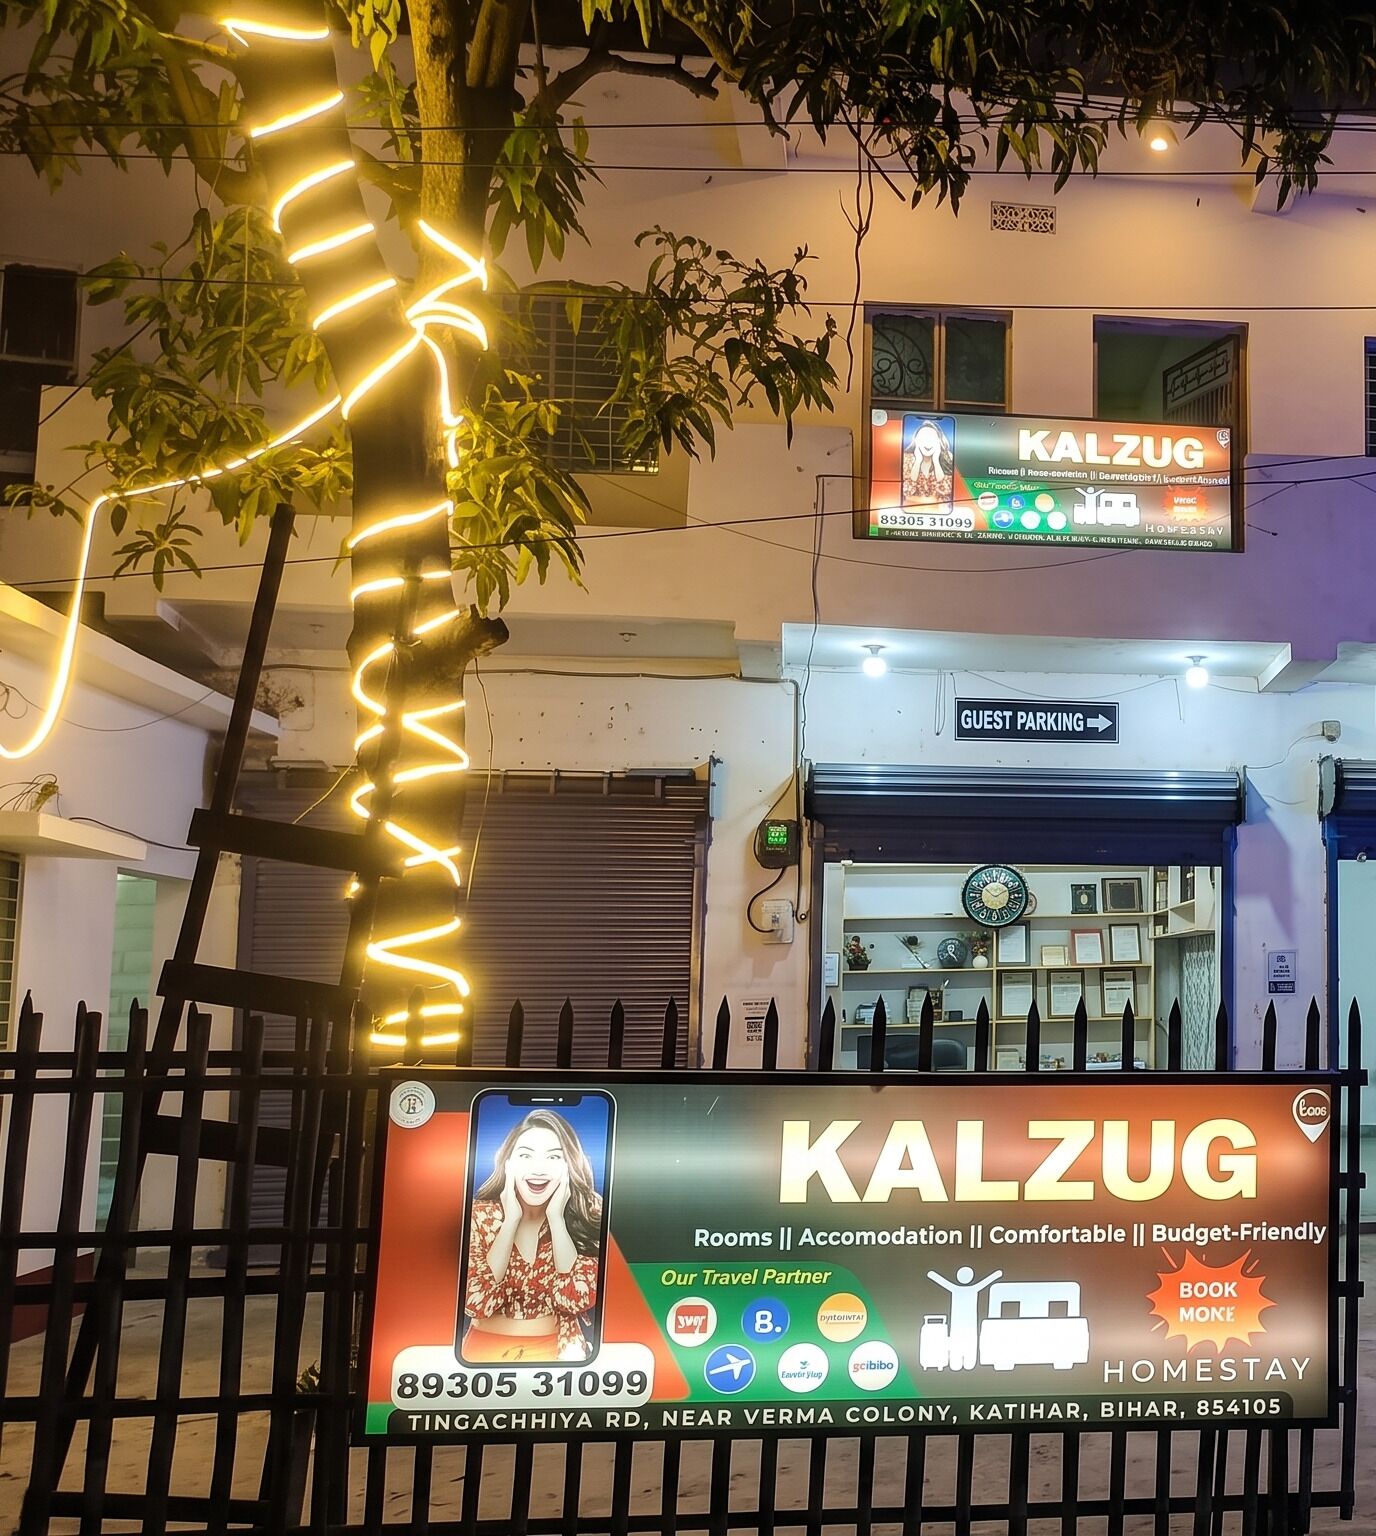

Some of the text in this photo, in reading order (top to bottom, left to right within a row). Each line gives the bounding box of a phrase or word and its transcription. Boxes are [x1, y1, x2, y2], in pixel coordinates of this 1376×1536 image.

[1019, 429, 1204, 469] KALZUG
[880, 514, 972, 529] 89305 31099
[961, 709, 1084, 732] GUEST PARKING
[779, 1119, 1258, 1203] KALZUG
[694, 1227, 773, 1248] Rooms
[798, 1225, 963, 1248] Accomodation
[989, 1224, 1126, 1246] Comfortable
[1152, 1221, 1327, 1246] Budget-Friendly
[661, 1267, 832, 1286] Our Travel Partner
[1179, 1281, 1238, 1299] BOOK
[1104, 1357, 1311, 1384] HOMESTAY
[398, 1370, 648, 1400] 89305 31099
[409, 1398, 1281, 1431] TINGACHHIYA RD, NEAR VERMA COLONY, KATIHAR, BIHAR, 854105
